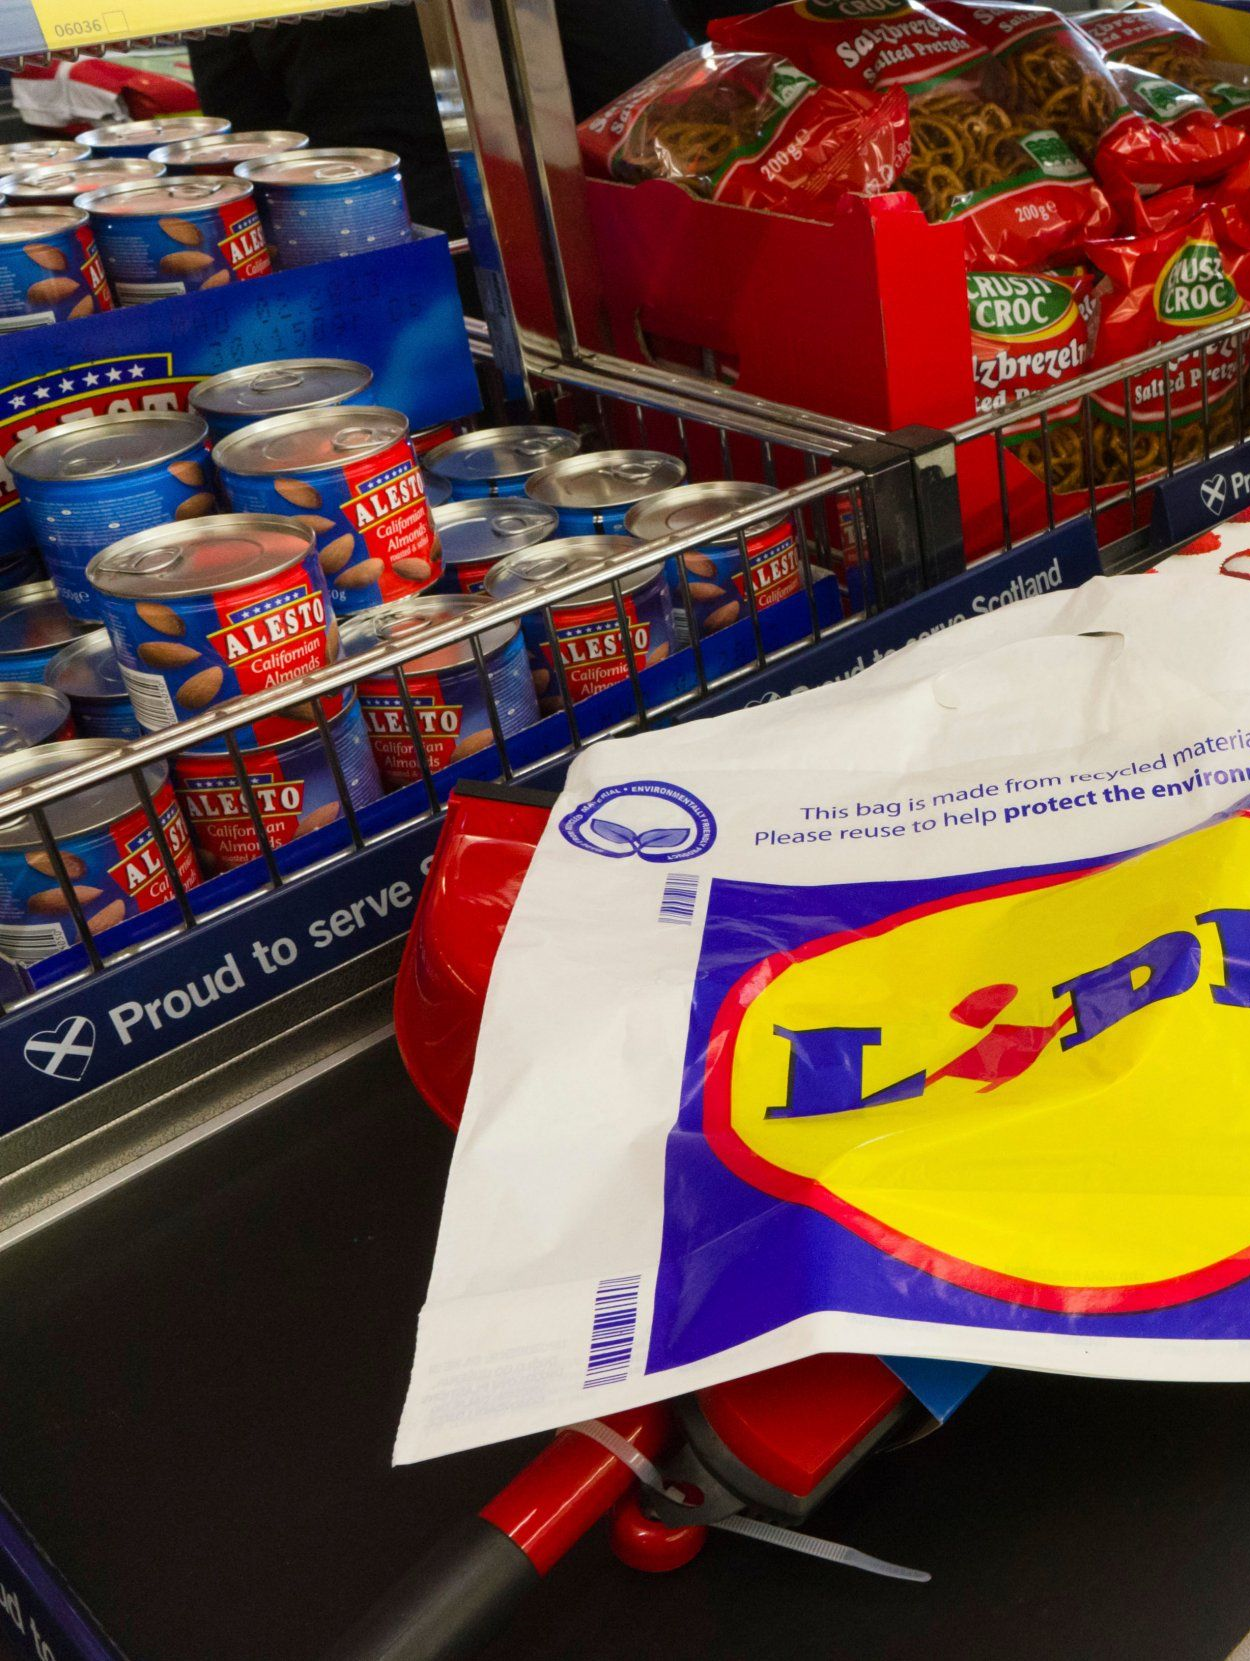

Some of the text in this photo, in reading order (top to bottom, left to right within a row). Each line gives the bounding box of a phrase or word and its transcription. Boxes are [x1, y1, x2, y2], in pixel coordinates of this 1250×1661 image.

[54, 17, 102, 38] 06036
[230, 226, 266, 263] ALES
[975, 296, 1049, 328] CROC
[1164, 282, 1226, 313] CROC
[356, 472, 424, 527] ALESTO
[376, 507, 425, 539] Californian
[388, 522, 427, 552] Almonds
[753, 547, 798, 591] LEST
[972, 557, 1063, 615] Scotland
[226, 598, 324, 660] ALESTO
[561, 629, 647, 664] LESO
[251, 638, 320, 674] Californian
[265, 655, 320, 688] Almonds
[631, 786, 705, 820] ENVIRONMENTALLY
[801, 806, 848, 821] This
[856, 800, 902, 823] bag
[909, 796, 925, 812] is
[933, 781, 999, 807] made
[1005, 773, 1062, 795] from
[1069, 752, 1168, 787] recycled
[755, 828, 831, 847] Please
[840, 822, 905, 841] reuse
[913, 817, 936, 833] to
[943, 805, 997, 831] help
[1004, 790, 1096, 823] protect
[1103, 782, 1145, 803] the
[126, 815, 188, 889] ALST
[108, 881, 414, 1045] Proud to serve
